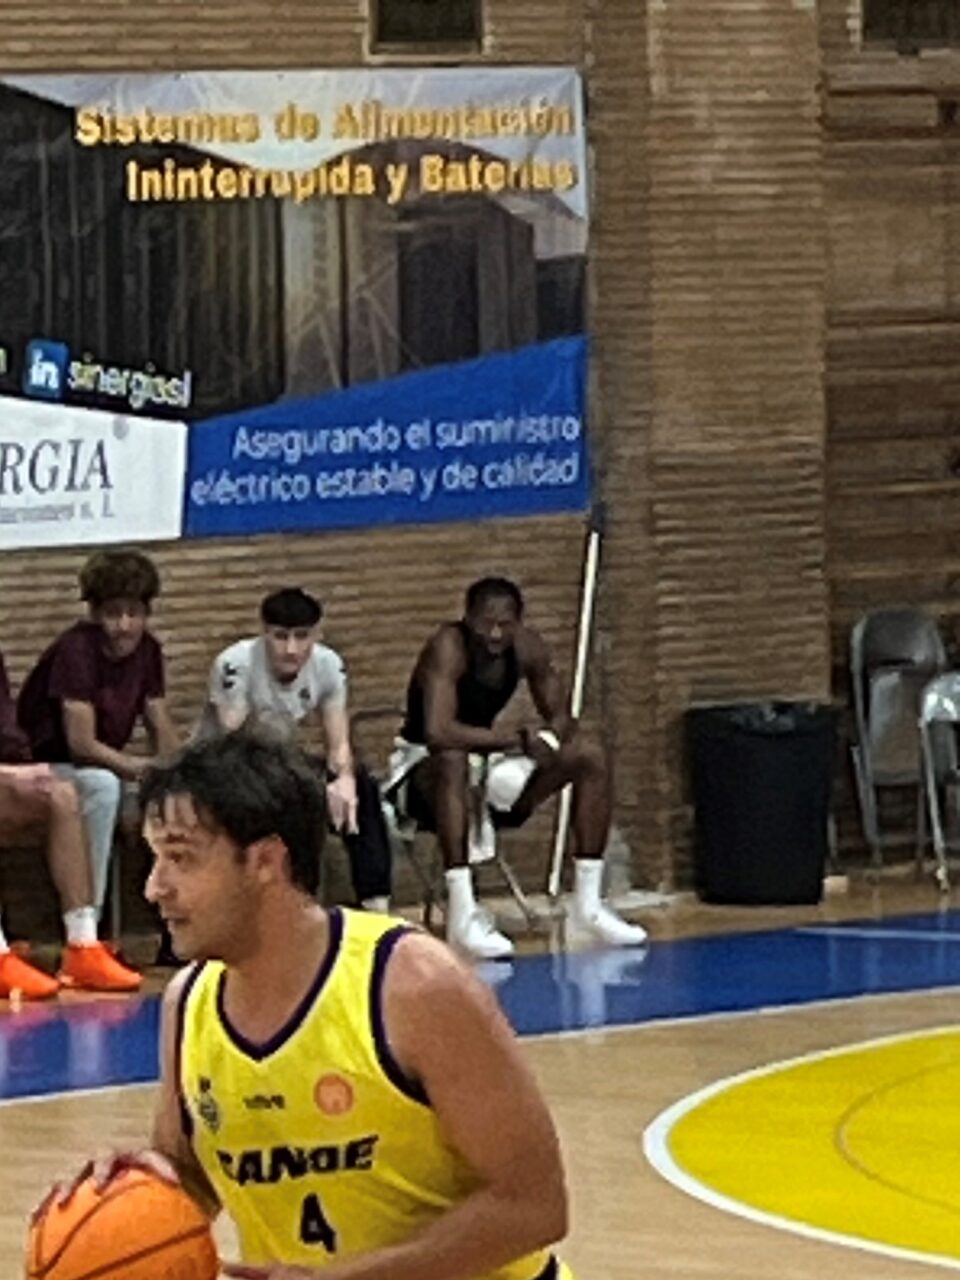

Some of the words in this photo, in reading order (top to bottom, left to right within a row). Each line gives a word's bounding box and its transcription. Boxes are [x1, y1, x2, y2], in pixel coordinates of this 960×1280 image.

[75, 107, 260, 145] Sistemas
[276, 103, 319, 141] de
[127, 155, 375, 203] Ininterrupida
[386, 163, 408, 204] y
[30, 349, 59, 389] in
[232, 416, 401, 464] Asegurando
[405, 419, 431, 450] el
[436, 412, 580, 449] suministro
[190, 466, 310, 506] eléctrico
[316, 461, 415, 499] estable
[419, 468, 437, 502] y
[442, 460, 479, 490] de
[482, 452, 579, 489] calidad
[299, 1191, 337, 1254] 4
